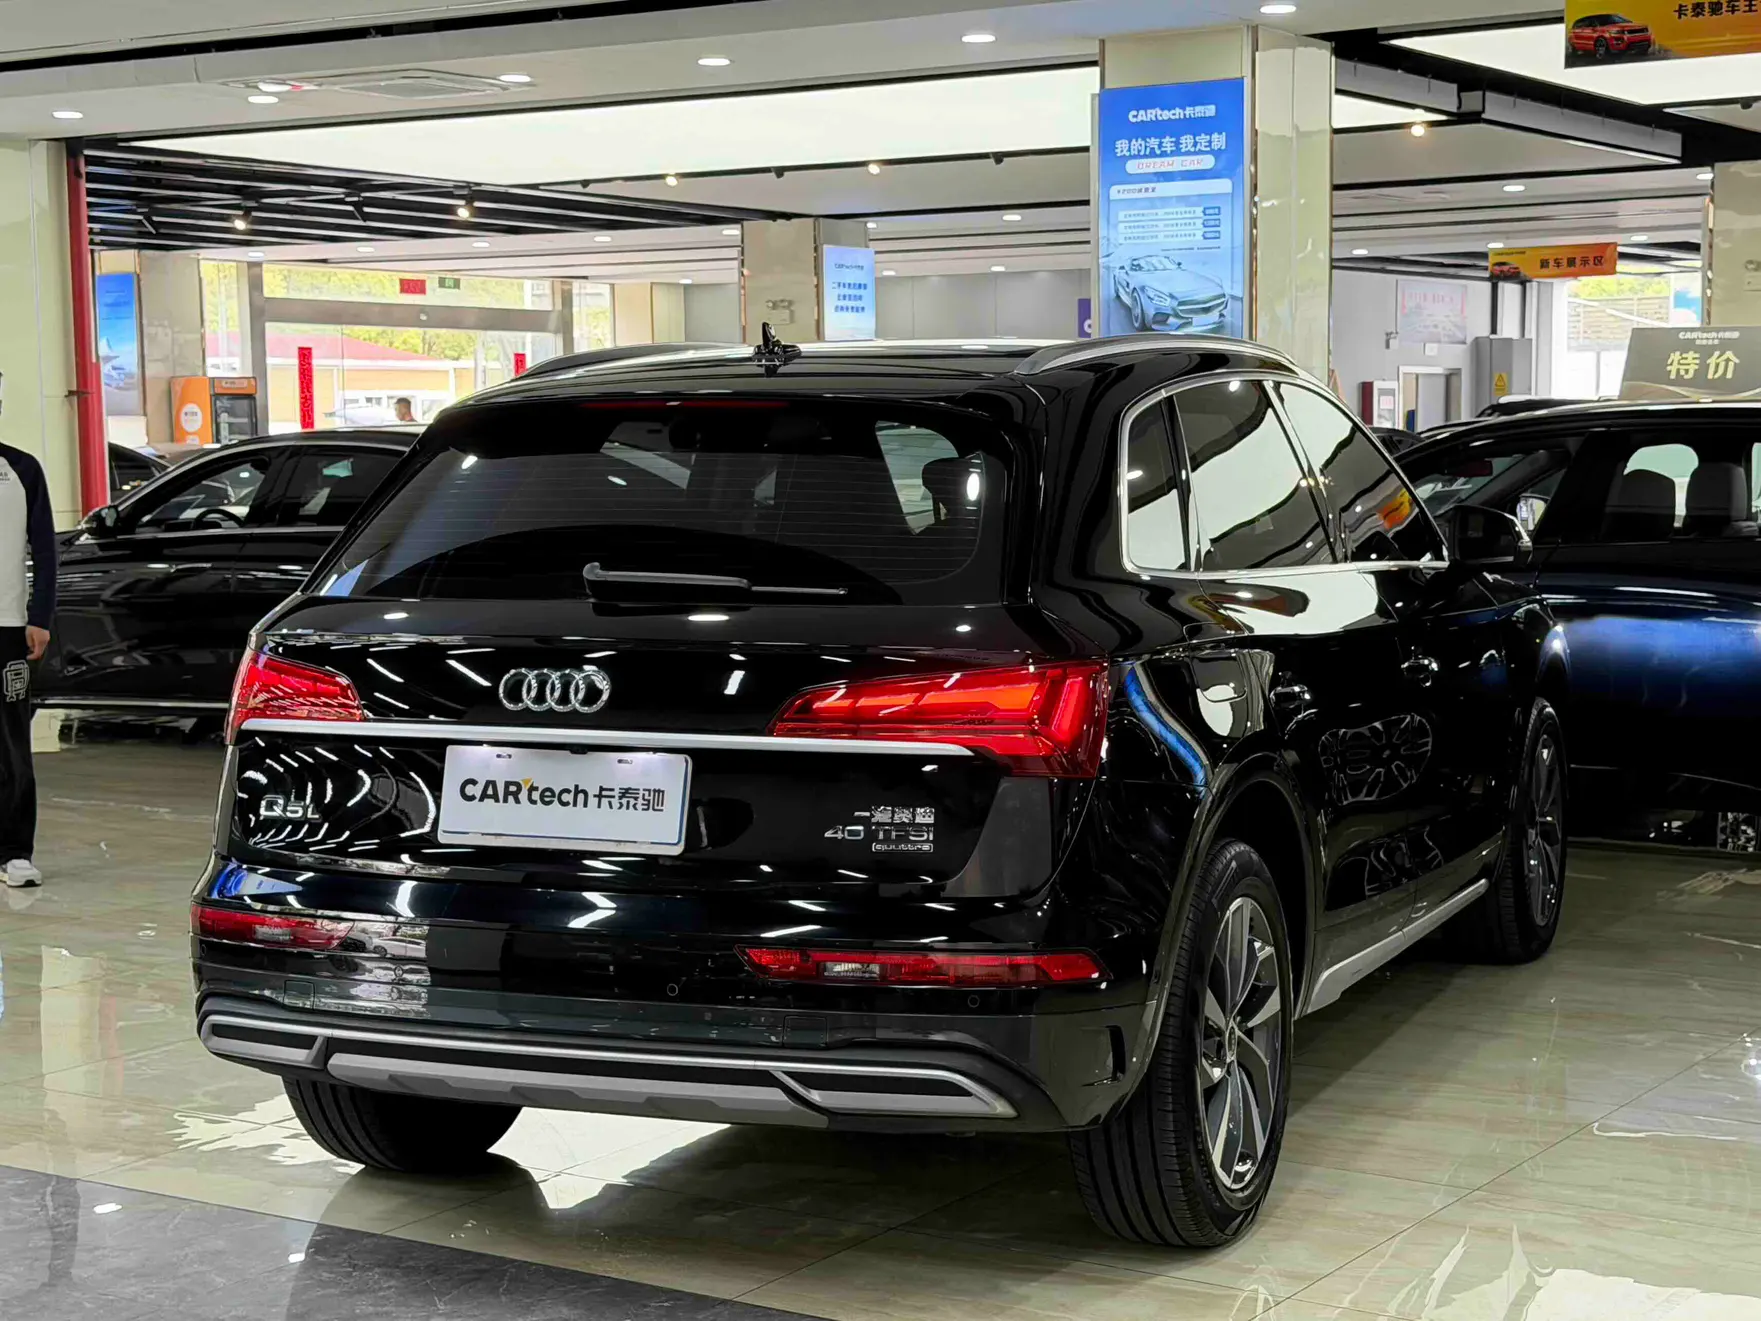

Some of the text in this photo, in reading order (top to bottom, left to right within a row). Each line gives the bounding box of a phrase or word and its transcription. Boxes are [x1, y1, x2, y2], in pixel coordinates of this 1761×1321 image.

[1115, 132, 1226, 156] 我的汽车 我定制
[1539, 255, 1604, 270] 新车展示区
[1666, 350, 1740, 379] 特价
[259, 794, 320, 819] Q5L
[824, 825, 934, 841] 40 TFSI
